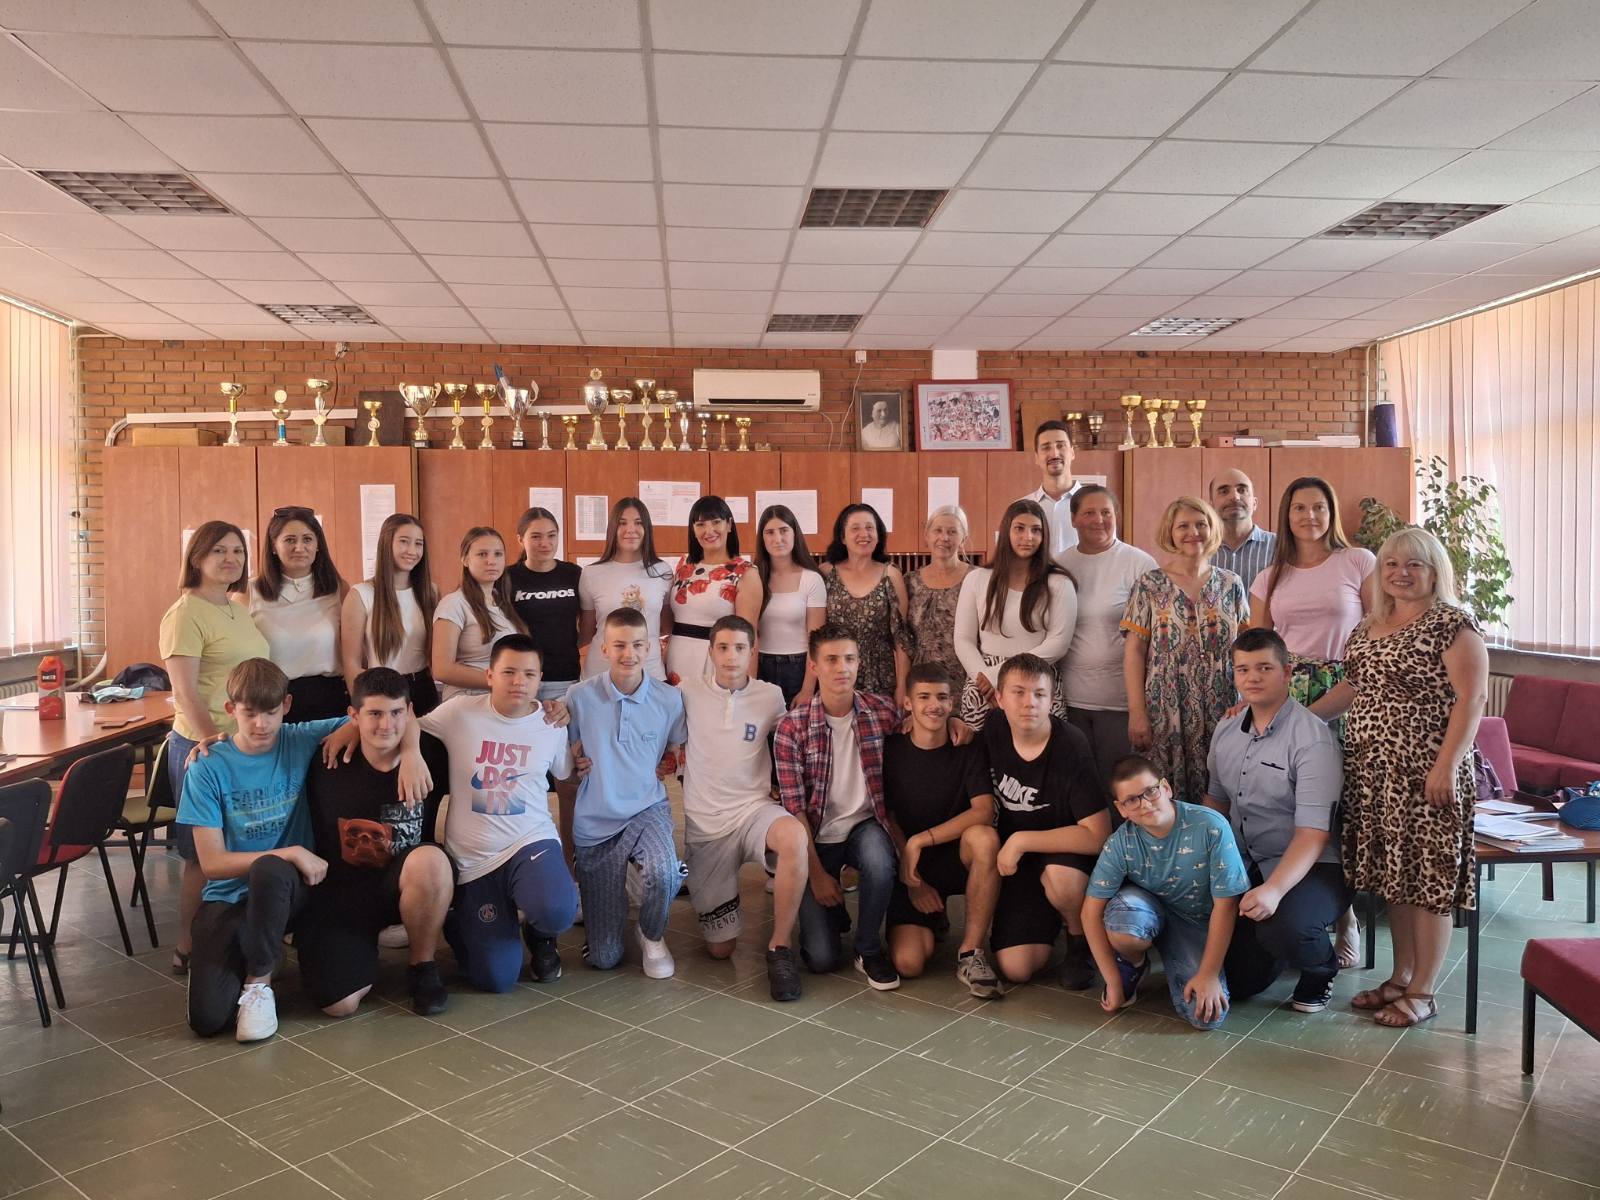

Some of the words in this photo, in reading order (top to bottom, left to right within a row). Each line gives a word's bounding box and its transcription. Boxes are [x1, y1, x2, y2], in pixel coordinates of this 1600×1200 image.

[515, 588, 575, 602] kronos
[743, 722, 757, 742] B
[475, 740, 532, 768] JUST
[483, 765, 518, 792] DO
